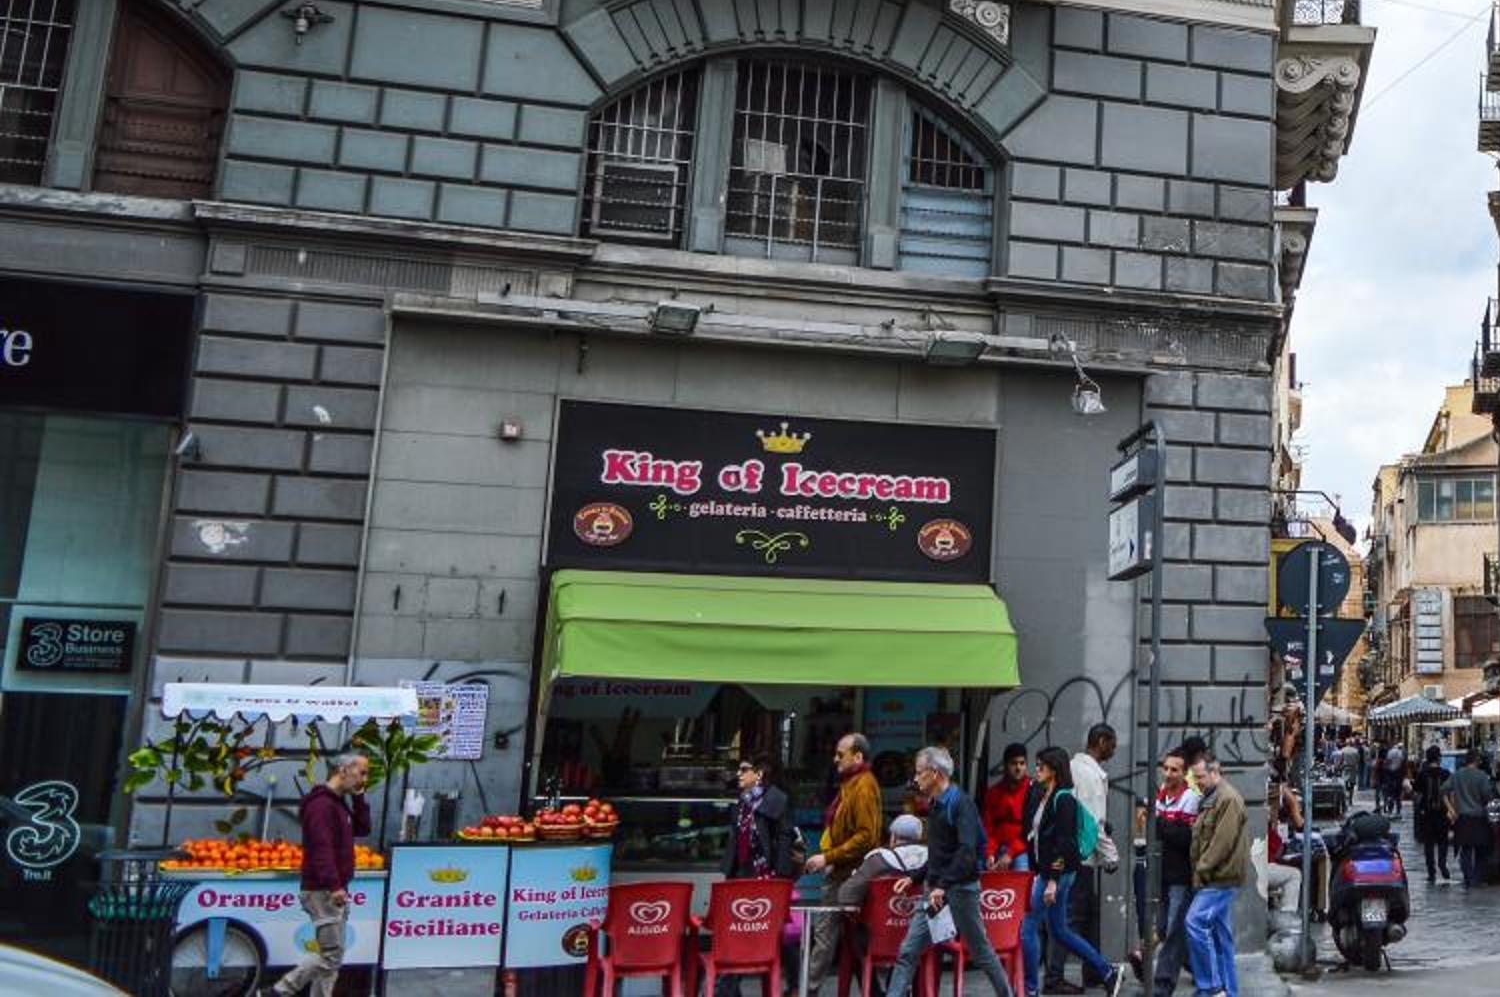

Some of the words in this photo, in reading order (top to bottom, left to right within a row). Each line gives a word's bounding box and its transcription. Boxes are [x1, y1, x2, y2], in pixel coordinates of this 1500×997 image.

[601, 450, 702, 495] King
[719, 458, 764, 492] of
[781, 462, 951, 503] Icecream
[689, 500, 767, 519] gelateria
[776, 503, 867, 523] caffetteria
[66, 623, 126, 642] Store
[197, 889, 295, 912] Orange
[396, 890, 497, 908] Granite
[512, 888, 557, 904] King
[561, 887, 577, 901] of
[518, 909, 579, 922] Gelateria
[387, 918, 500, 938] Siciliane
[729, 921, 769, 932] ALGIDA
